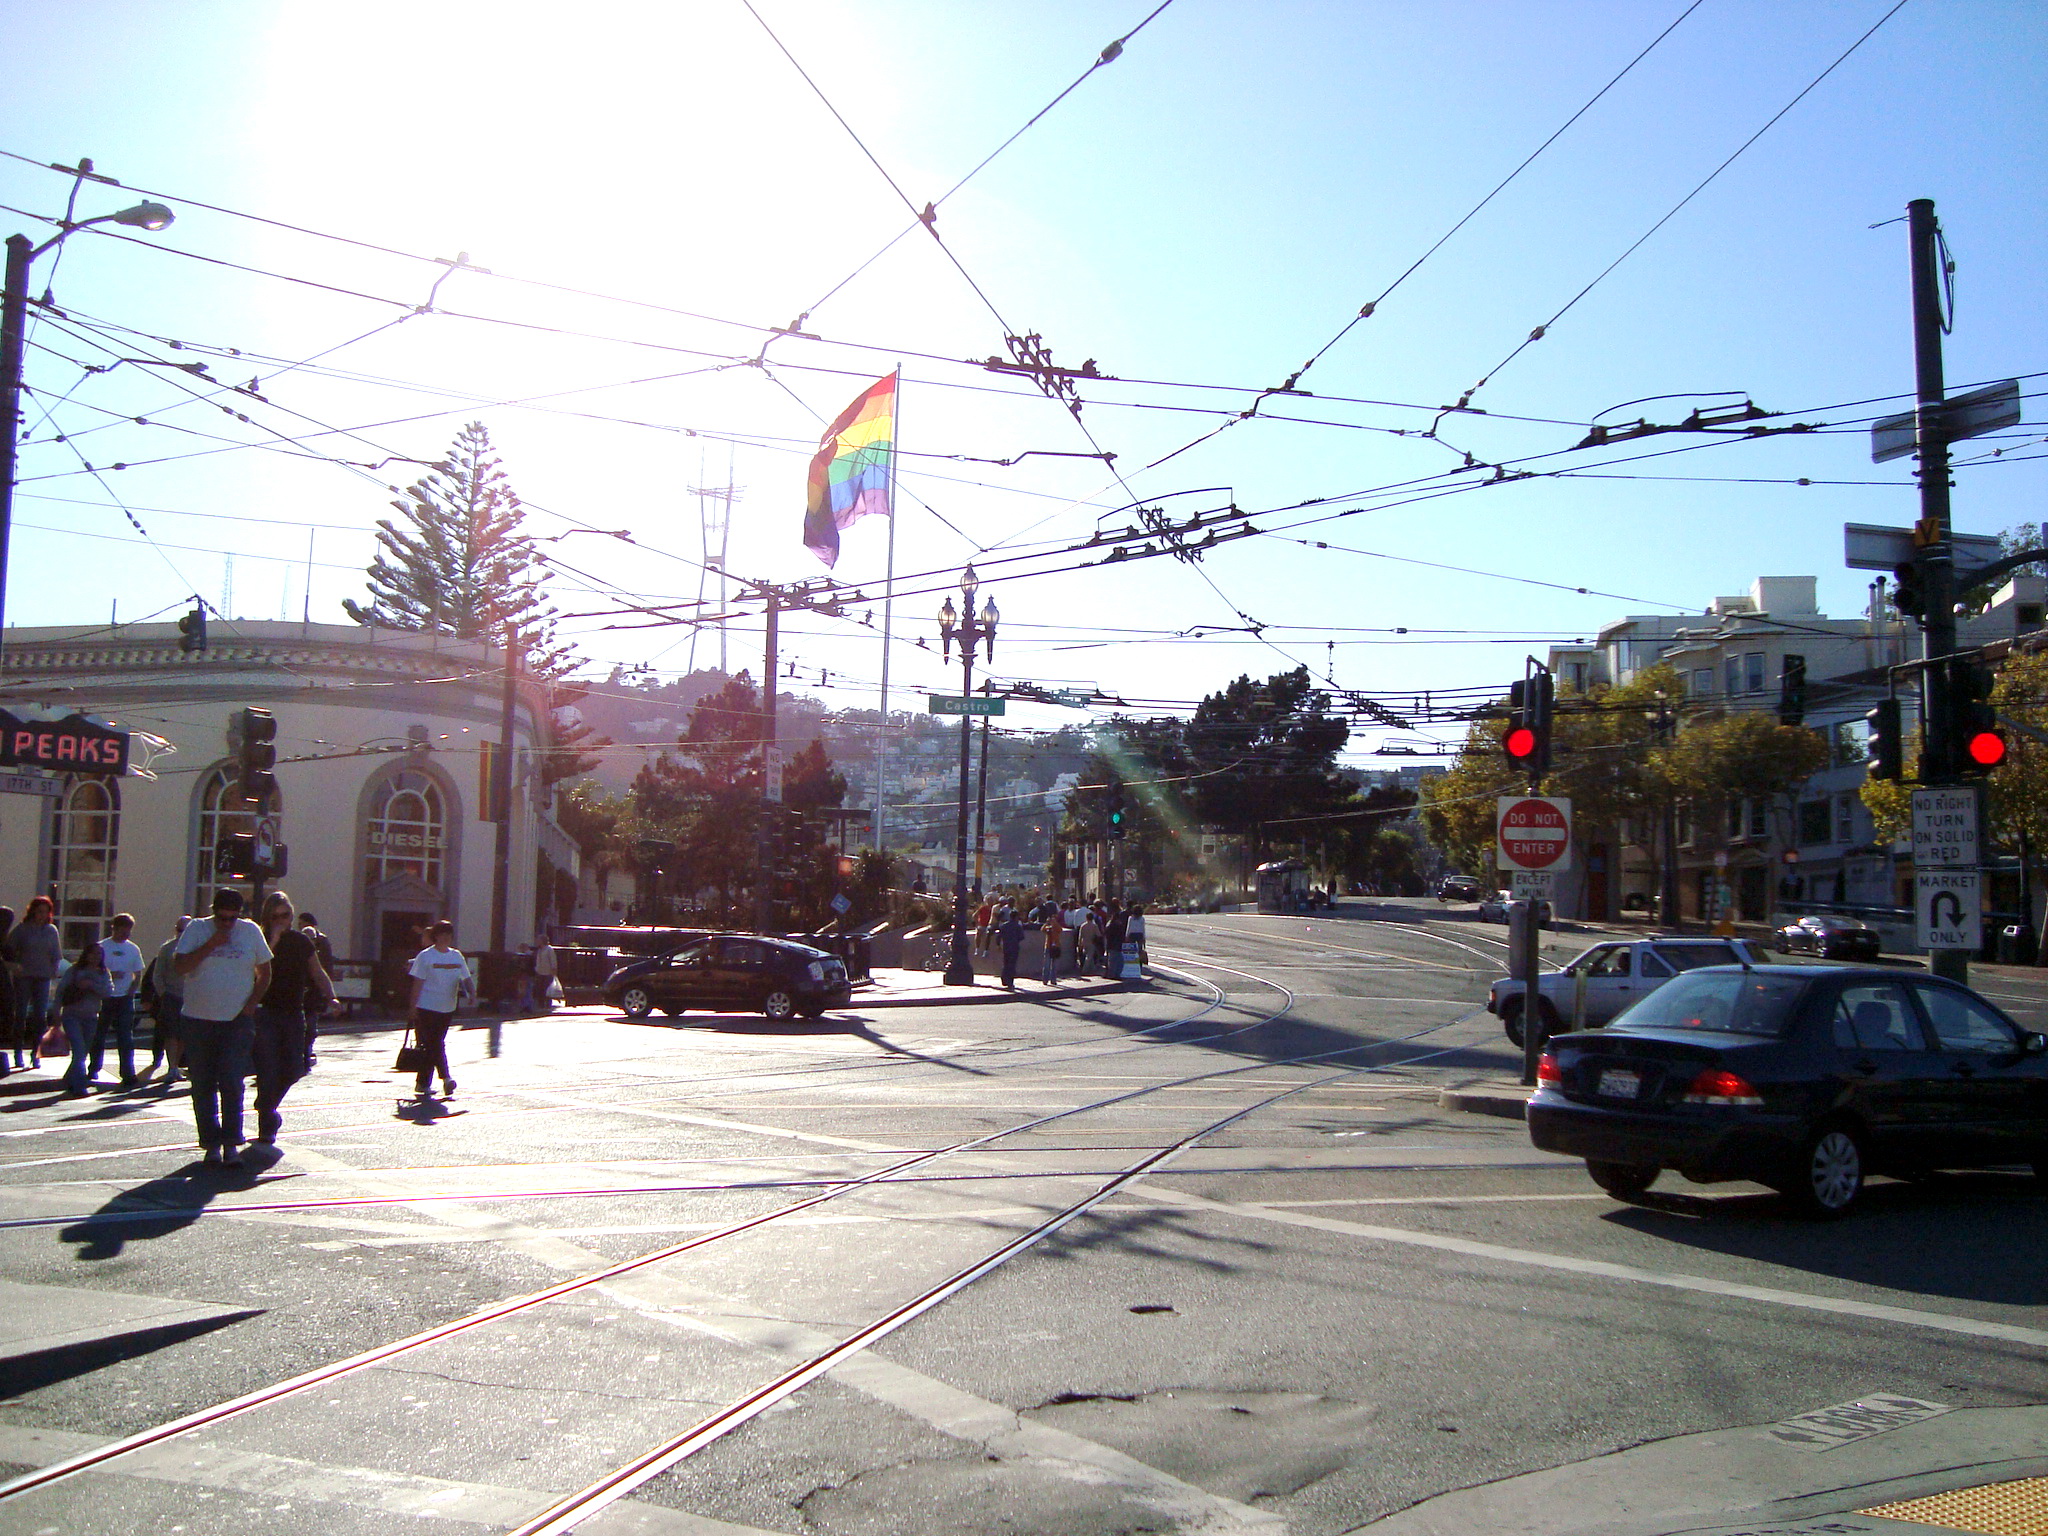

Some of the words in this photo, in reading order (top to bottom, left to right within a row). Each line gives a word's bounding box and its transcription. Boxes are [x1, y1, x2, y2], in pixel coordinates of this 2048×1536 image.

[944, 700, 990, 712] Castro
[14, 731, 121, 764] PEAKS
[7, 777, 32, 790] 17TH
[41, 780, 53, 792] ST
[1915, 798, 1931, 811] NO
[1936, 797, 1972, 810] RIGHT
[1510, 813, 1526, 824] DO
[1535, 814, 1559, 825] NOT
[1926, 815, 1964, 827] TURN
[371, 831, 448, 849] DIESEL
[1915, 832, 1931, 843] ON
[1936, 831, 1974, 843] SOLID
[1513, 843, 1555, 855] ENTER
[1931, 848, 1960, 860] RED
[1516, 874, 1551, 885] EXCEPT
[1919, 876, 1975, 889] MARKET
[1930, 931, 1967, 943] ONLY
